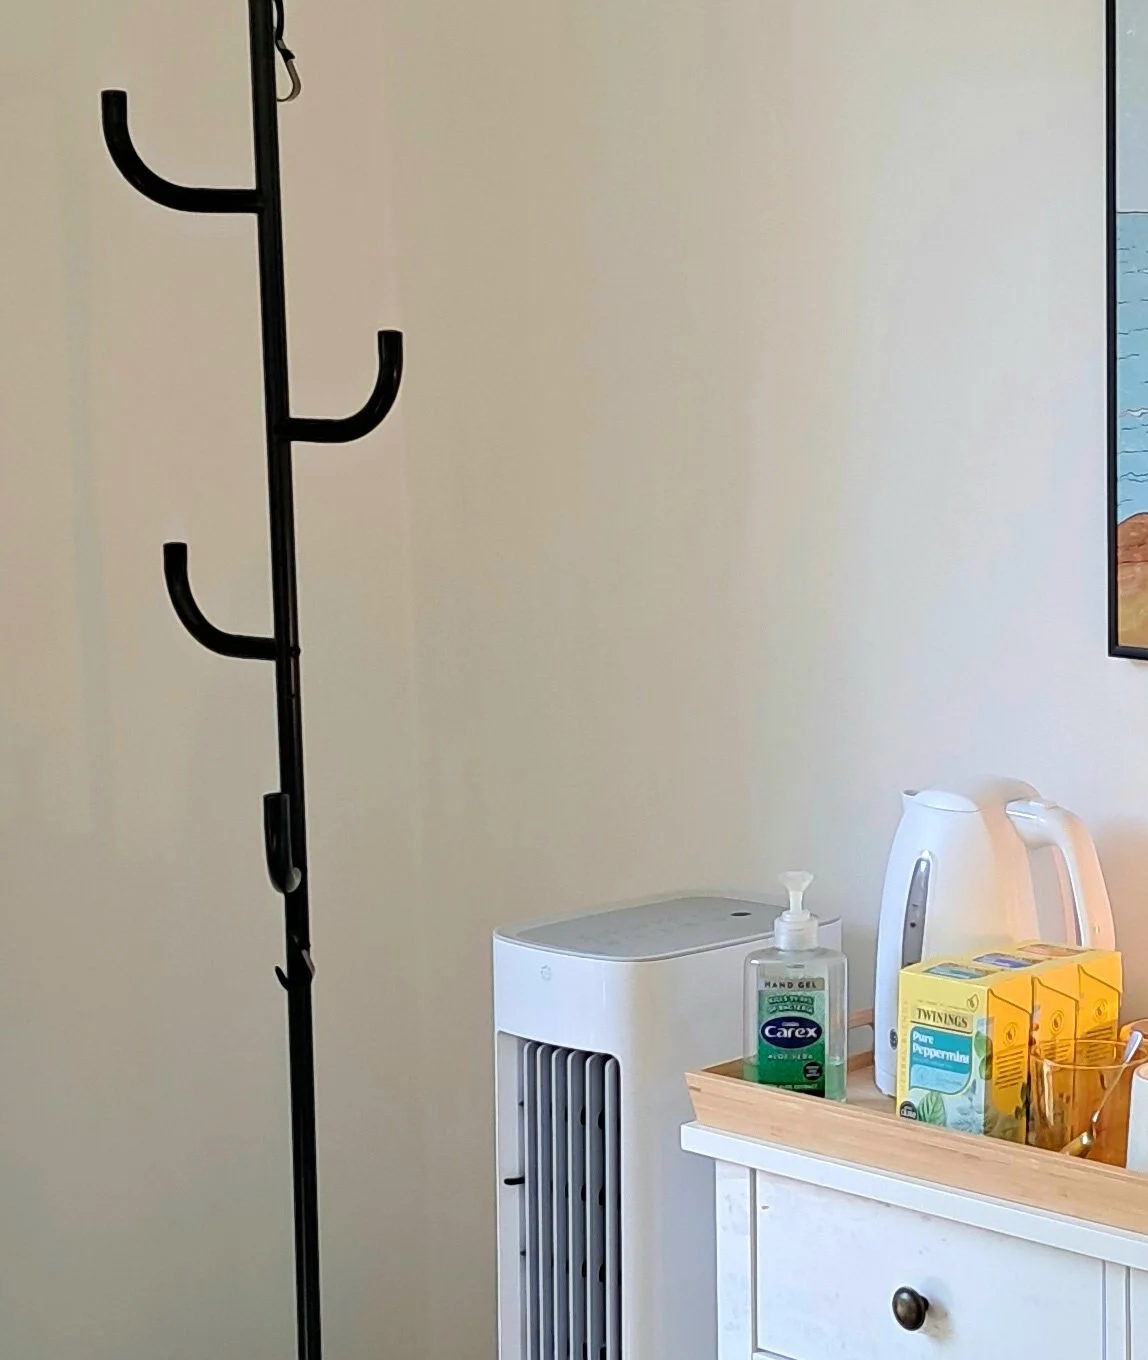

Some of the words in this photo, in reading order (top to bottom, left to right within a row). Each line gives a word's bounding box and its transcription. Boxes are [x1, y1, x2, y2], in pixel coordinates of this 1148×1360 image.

[764, 981, 793, 989] HAND
[798, 981, 817, 989] GEL
[916, 1008, 968, 1029] TWININGS
[764, 1025, 818, 1038] Carex
[912, 1031, 934, 1045] Pure
[912, 1044, 969, 1064] Peppermint
